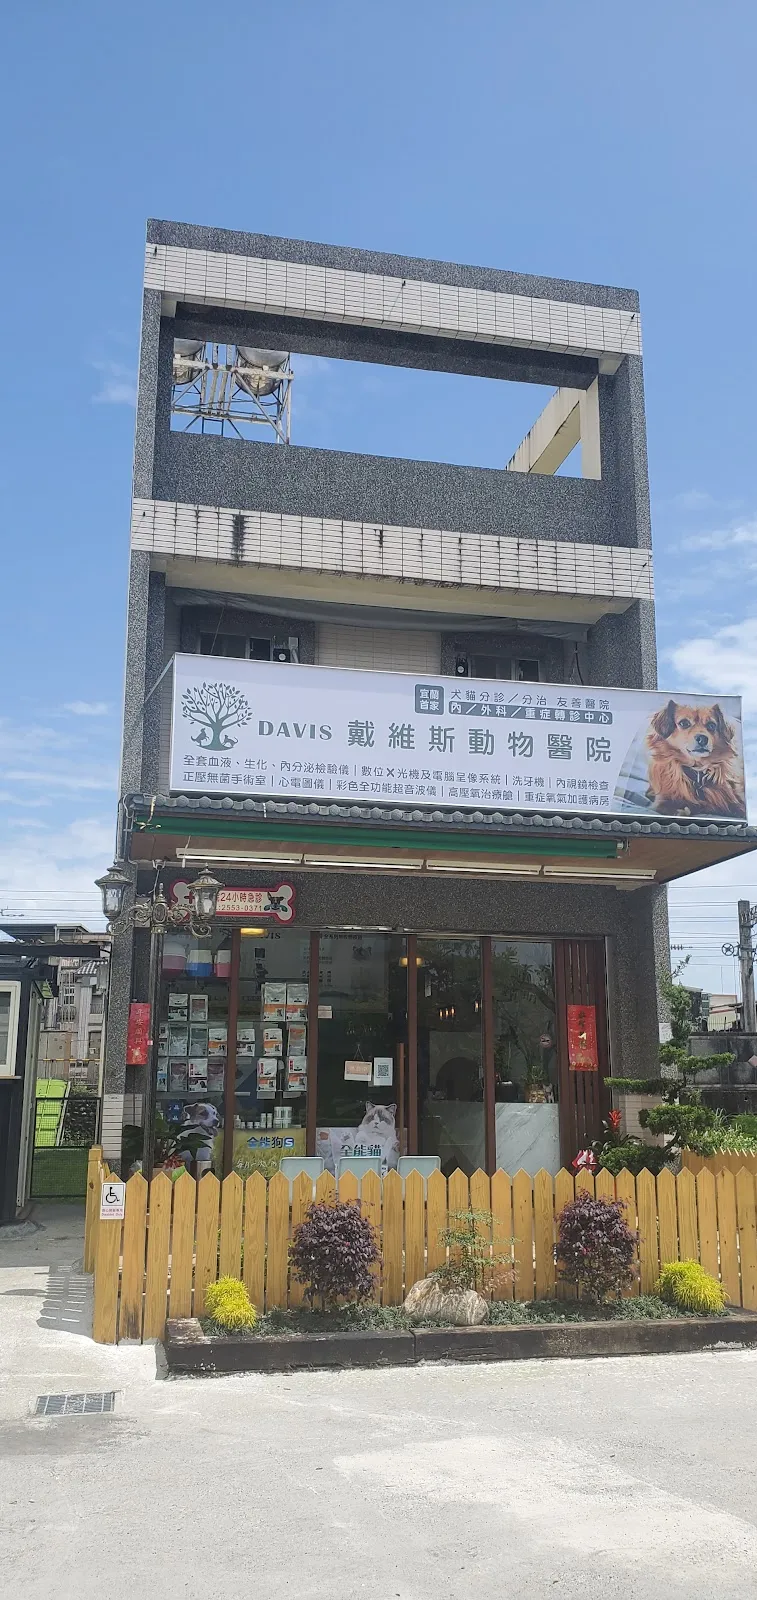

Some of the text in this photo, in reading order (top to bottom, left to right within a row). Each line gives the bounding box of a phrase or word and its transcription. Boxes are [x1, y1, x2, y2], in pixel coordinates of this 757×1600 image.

[419, 689, 440, 699] 宜蘭
[419, 699, 440, 711] 首家
[556, 697, 610, 710] 友善醫院
[258, 720, 332, 740] DAVIS
[347, 719, 612, 763] 戴維斯動物醫院
[182, 771, 266, 786] 正壓無菌手術室
[278, 776, 324, 790] 心電圖儀
[336, 780, 437, 797] 彩色全功能超音波儀
[512, 775, 545, 788] 洗牙機
[556, 778, 609, 791] 內視鏡檢查
[340, 1144, 381, 1156] 全能貓
